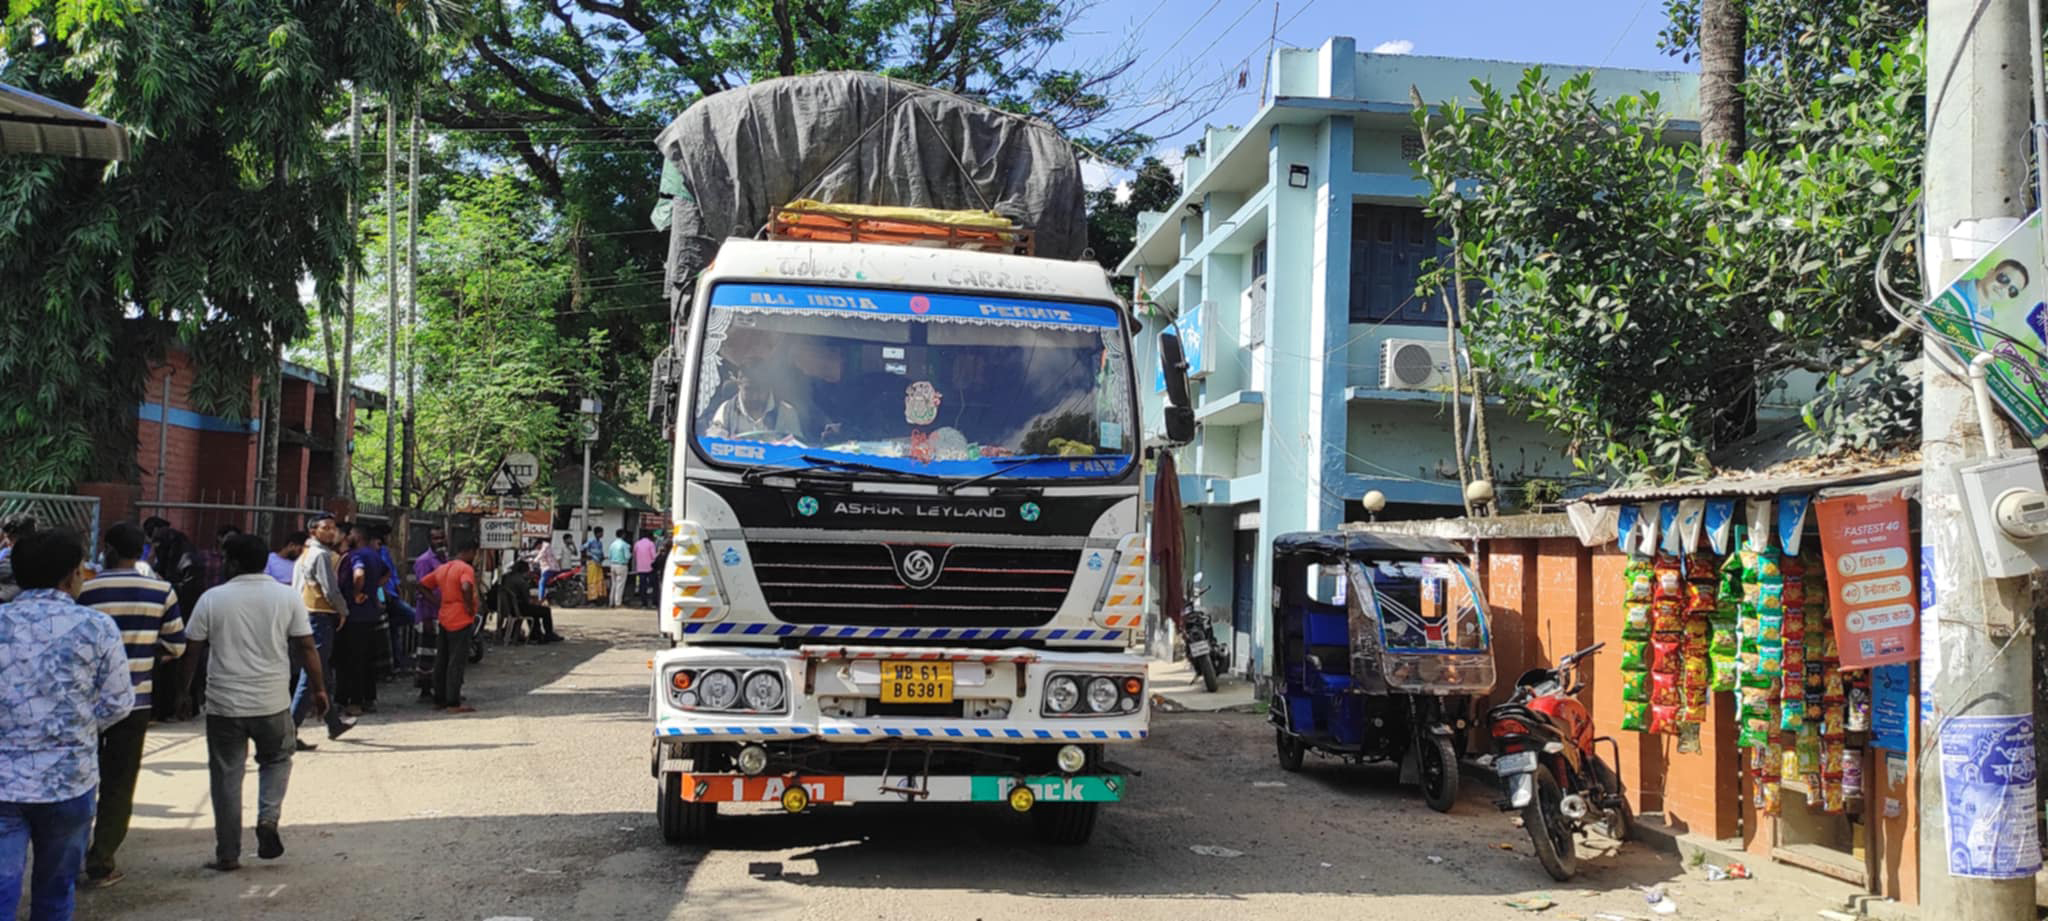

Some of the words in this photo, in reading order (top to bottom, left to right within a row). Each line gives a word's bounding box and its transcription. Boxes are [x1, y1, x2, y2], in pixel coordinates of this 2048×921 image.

[751, 292, 795, 305] ALL
[807, 294, 880, 310] INDIA
[979, 303, 1073, 322] PERMIT
[834, 502, 904, 516] ASHOK
[916, 505, 1006, 518] LEYLAND
[1844, 522, 1885, 537] FASTEST
[1886, 520, 1900, 531] 4G
[895, 665, 913, 681] WB
[921, 665, 938, 681] 61
[894, 683, 903, 698] B
[907, 683, 944, 698] 6381
[731, 778, 744, 801] I
